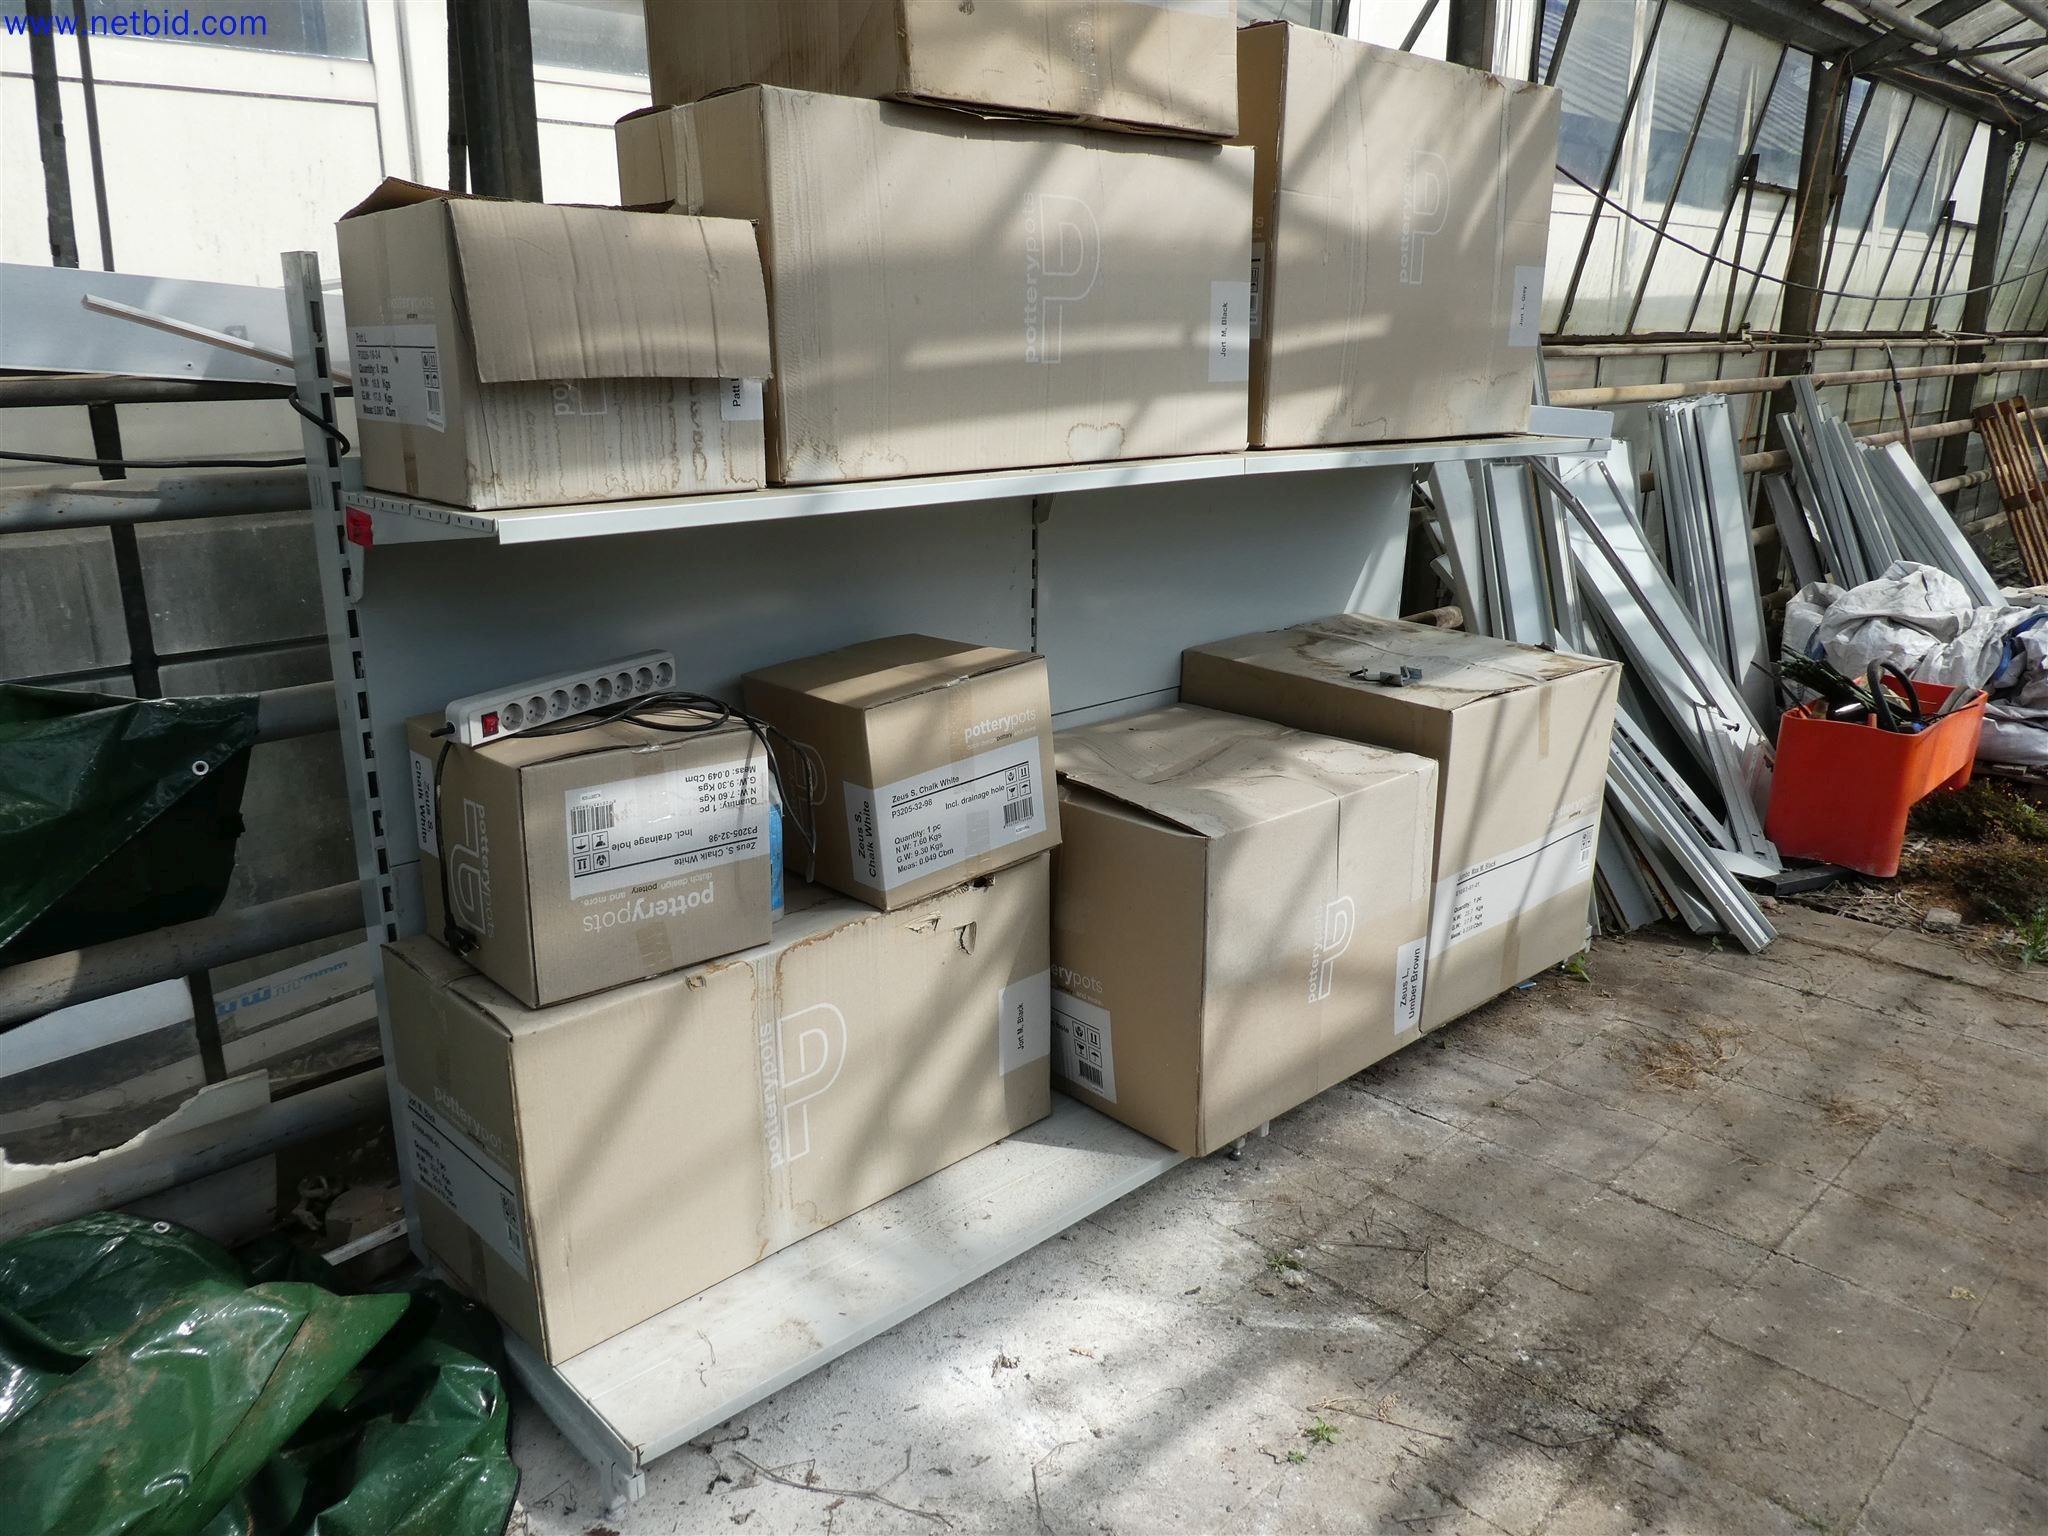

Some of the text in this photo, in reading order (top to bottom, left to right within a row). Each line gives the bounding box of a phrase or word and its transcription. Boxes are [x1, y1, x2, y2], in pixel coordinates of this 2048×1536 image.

[1023, 192, 1039, 363] potterypots
[733, 383, 741, 407] Patt
[965, 708, 1036, 744] potterypots
[685, 765, 756, 783] Meas: 0.049 Cbm
[717, 780, 735, 790] 9.30
[698, 783, 715, 792] Kgs
[699, 794, 716, 803] Kgs
[718, 790, 736, 800] 7.60
[892, 793, 909, 803] Zeus
[919, 782, 939, 794] Chalk
[940, 776, 960, 787] White
[945, 784, 1005, 810] Incl. drainage hole
[415, 760, 428, 844] Chalk White
[699, 797, 757, 813] Quantity: 1 pc
[891, 799, 933, 819] P3205-32-98
[611, 828, 693, 852] Incl. drainage hole
[708, 826, 758, 842] P3205-32-98
[857, 827, 866, 859] Zeus
[863, 800, 877, 878] Chalk White
[894, 830, 925, 845] Quantity:
[932, 823, 942, 832] pc
[914, 838, 928, 847] 7.60
[929, 833, 943, 842] Kgs
[700, 849, 724, 860] Chalk
[736, 842, 756, 850] Zeus
[896, 842, 944, 864] G.W: 9.30 Kgs
[476, 803, 496, 938] potterypots
[674, 855, 699, 865] White
[897, 848, 954, 874] Meas: 0.049 Cbm
[610, 892, 626, 902] and
[631, 883, 658, 894] pottery
[583, 881, 714, 933] potterypots
[1400, 980, 1409, 1008] Zeus
[1408, 947, 1420, 1020] Umber Brown
[1016, 1003, 1024, 1024] Black
[760, 1023, 785, 1169] potterypots
